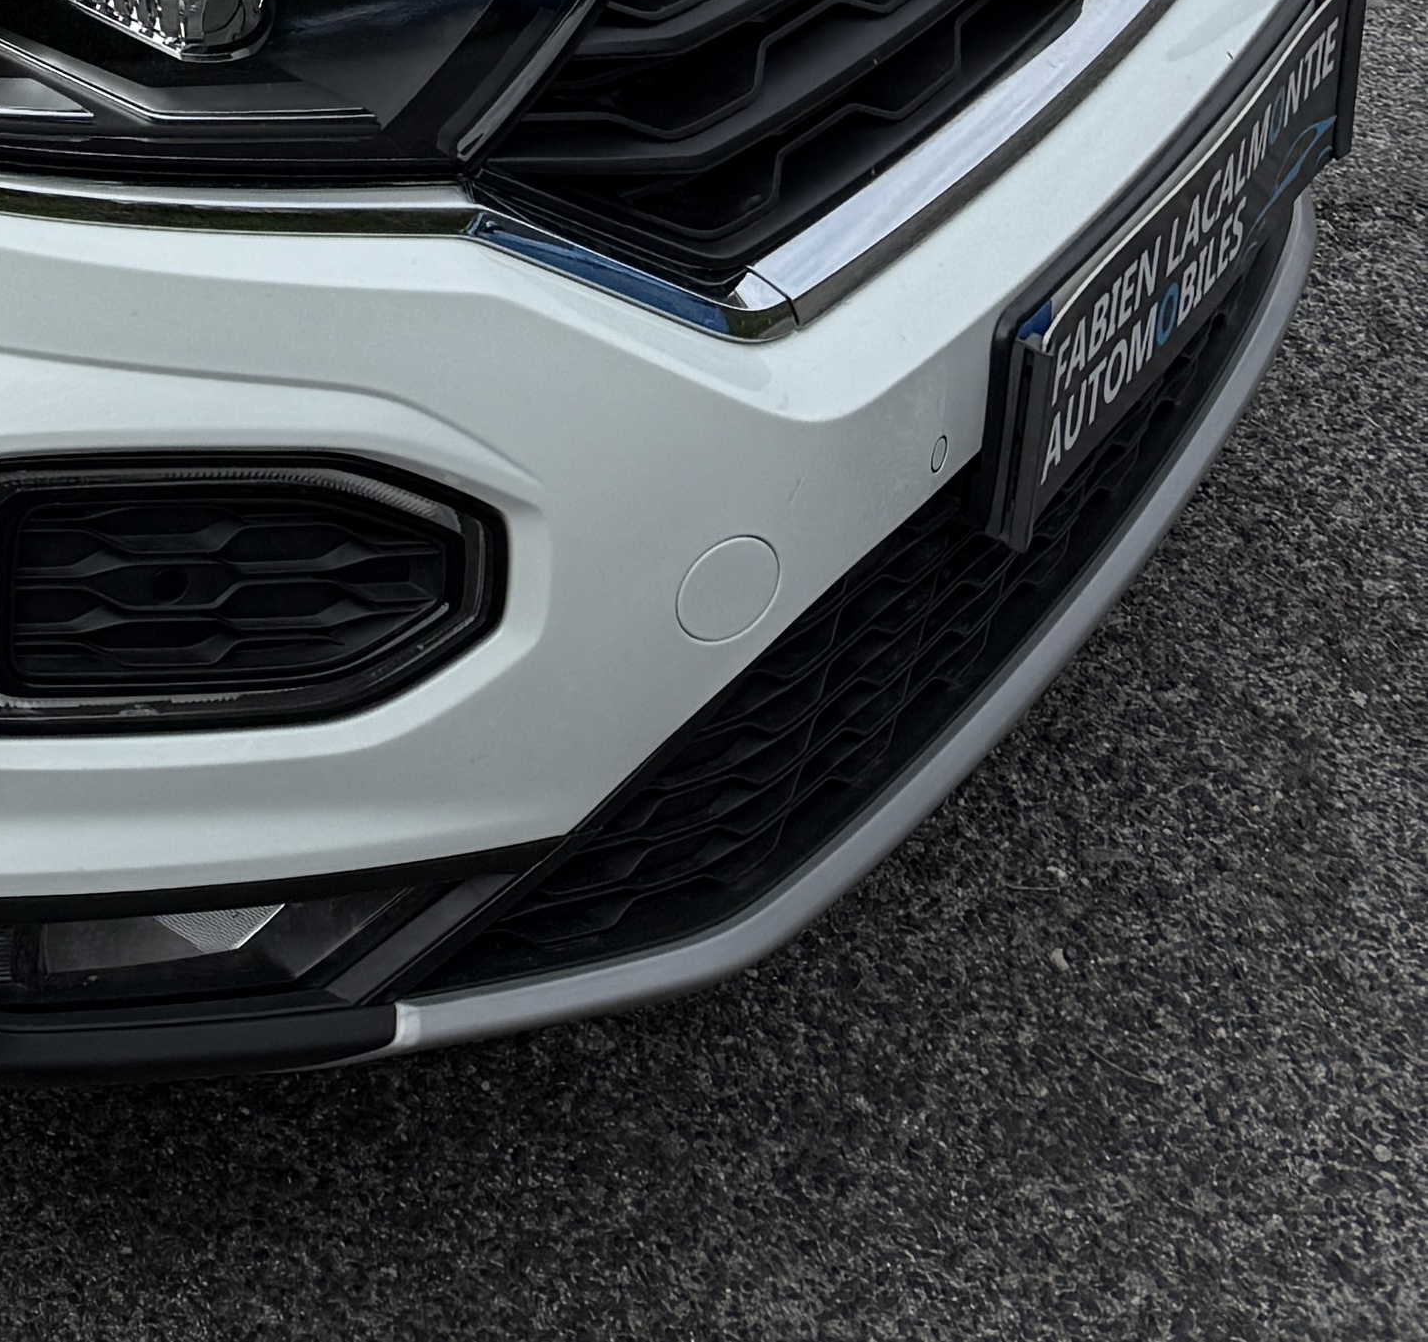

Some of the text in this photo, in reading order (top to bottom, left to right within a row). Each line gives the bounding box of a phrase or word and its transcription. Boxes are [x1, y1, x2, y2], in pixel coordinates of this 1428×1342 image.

[1040, 196, 1248, 485] AUTOMOBILES
[1050, 17, 1340, 407] FABIEN LACALMONTIE
